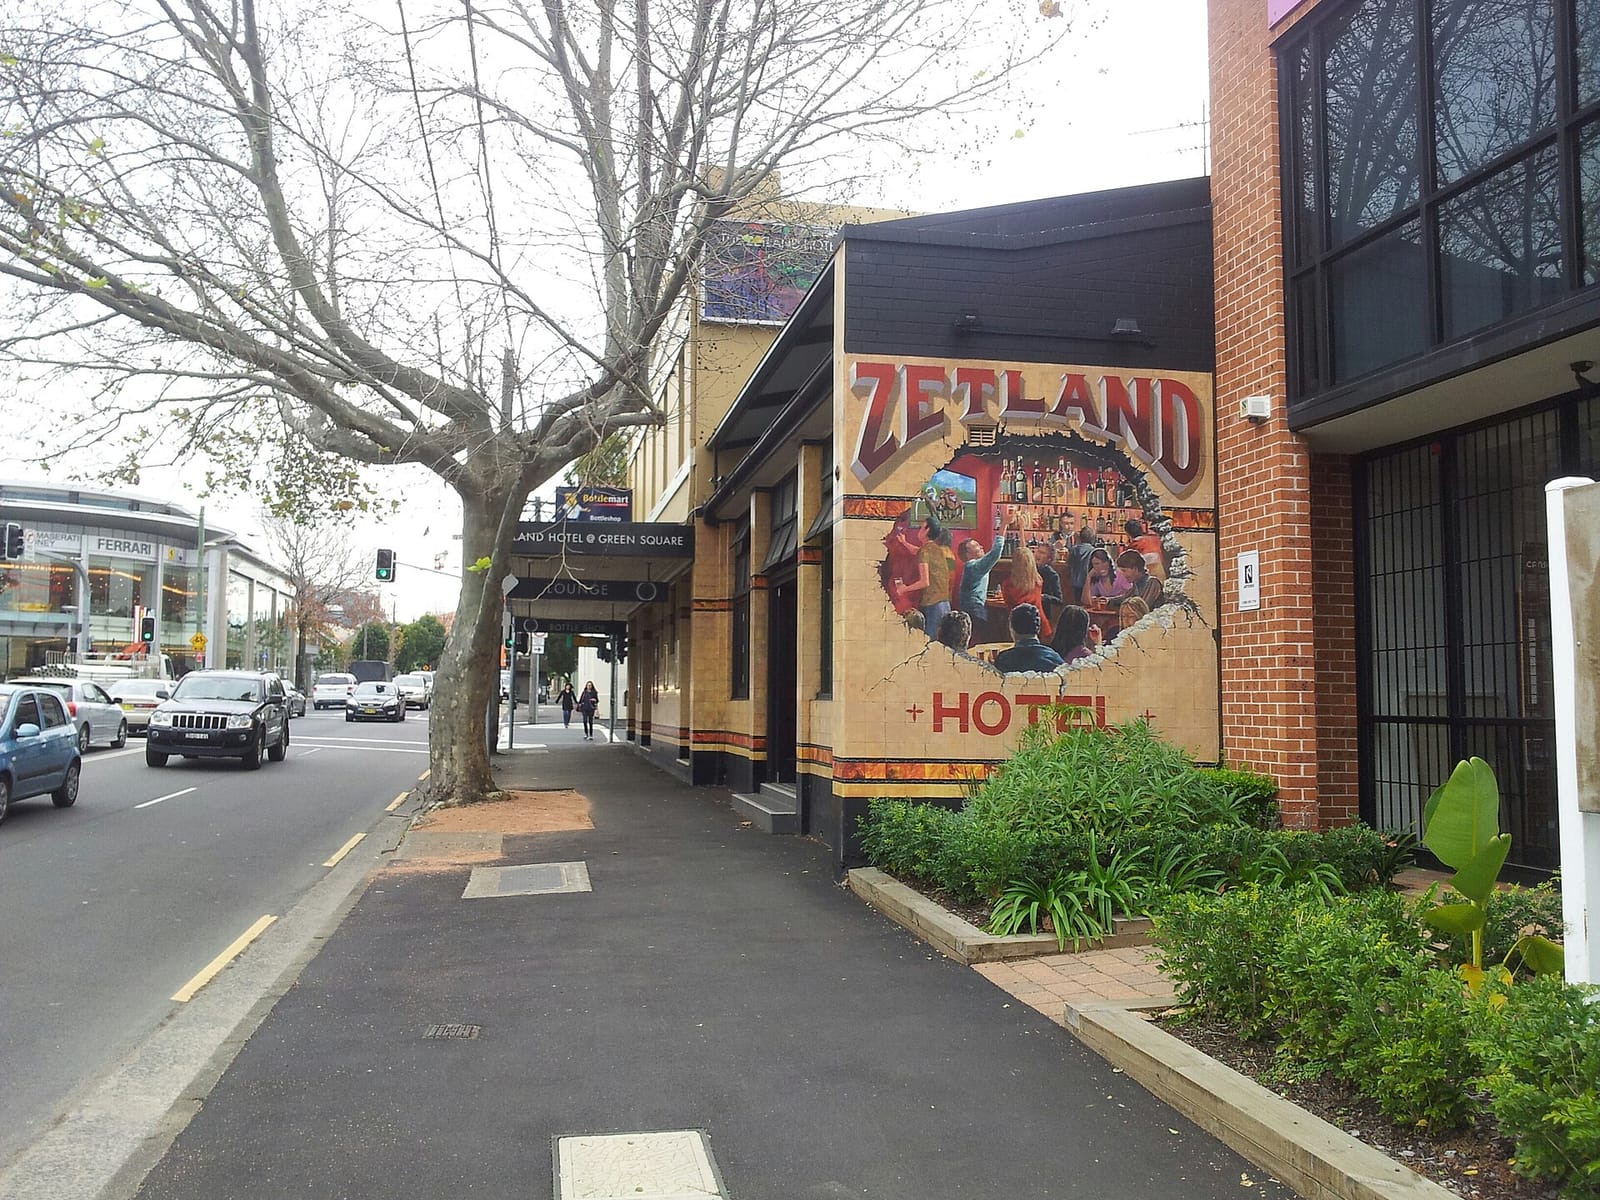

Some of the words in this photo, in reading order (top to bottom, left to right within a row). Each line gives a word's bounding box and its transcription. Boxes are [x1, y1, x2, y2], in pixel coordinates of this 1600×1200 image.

[849, 361, 1201, 496] ZETLAND
[583, 494, 629, 503] Bottlemart
[36, 532, 80, 542] MASERATI
[548, 533, 584, 543] HOTEL
[586, 534, 596, 544] @
[598, 534, 636, 545] GREEN
[640, 535, 684, 546] SQUARE
[97, 538, 152, 555] FERRARI
[547, 583, 609, 596] LOUNGE
[932, 691, 1126, 736] HOTEL
